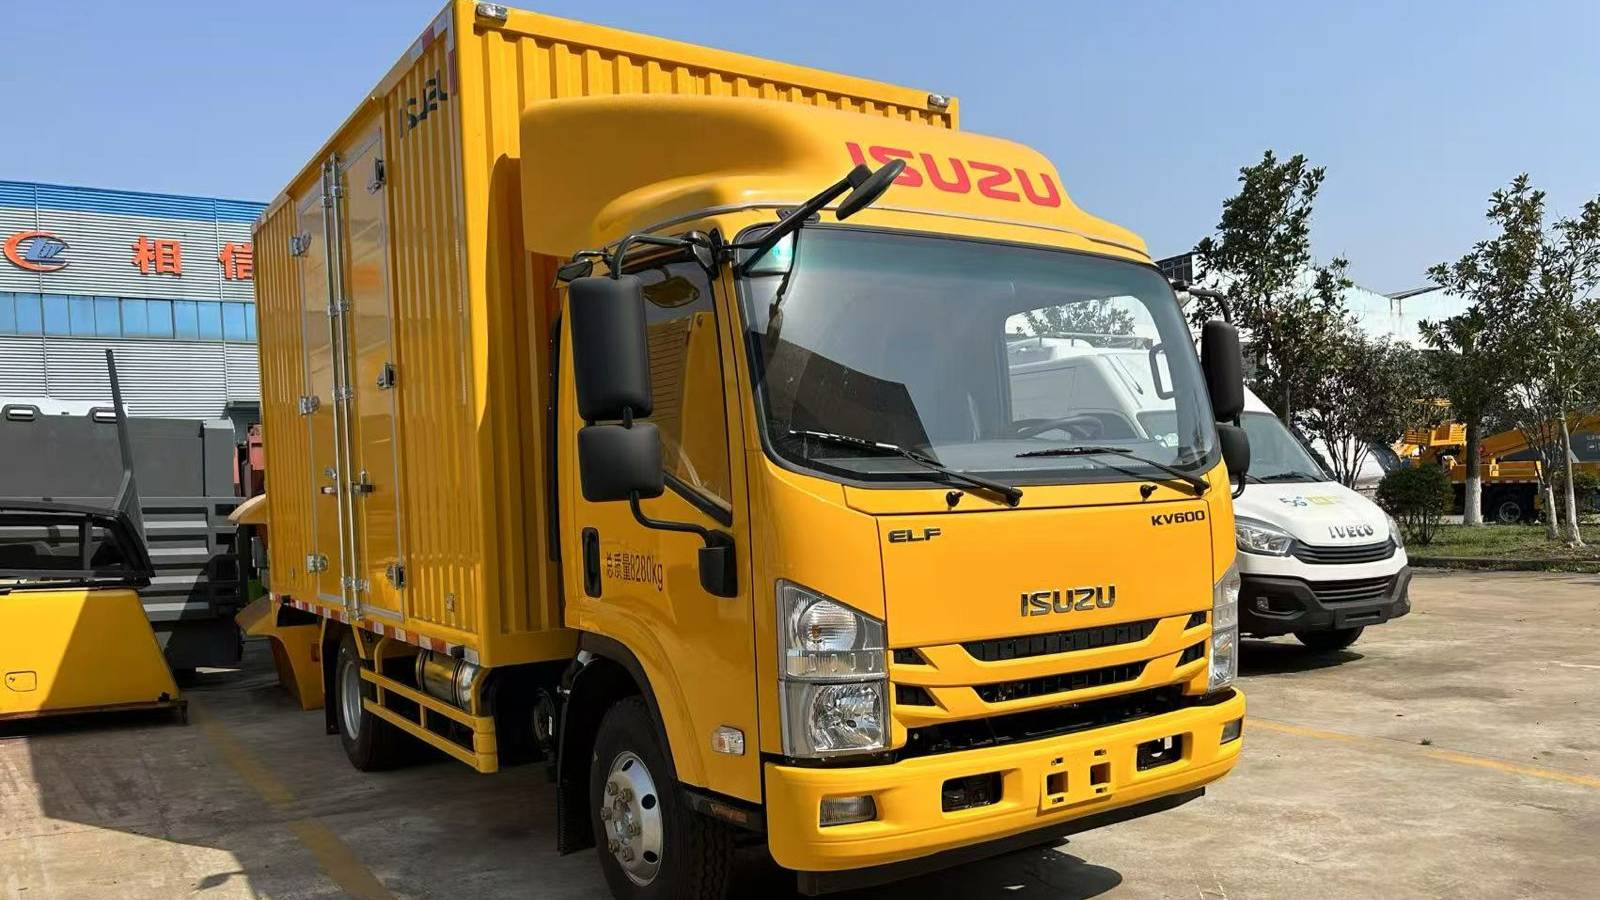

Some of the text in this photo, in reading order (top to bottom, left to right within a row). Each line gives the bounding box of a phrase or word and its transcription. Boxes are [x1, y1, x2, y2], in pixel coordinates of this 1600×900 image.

[845, 142, 1061, 208] ISUZU
[1151, 510, 1206, 526] KV600
[888, 527, 942, 544] ELF
[1328, 524, 1374, 539] IVECO
[1020, 584, 1116, 617] ISUZU
